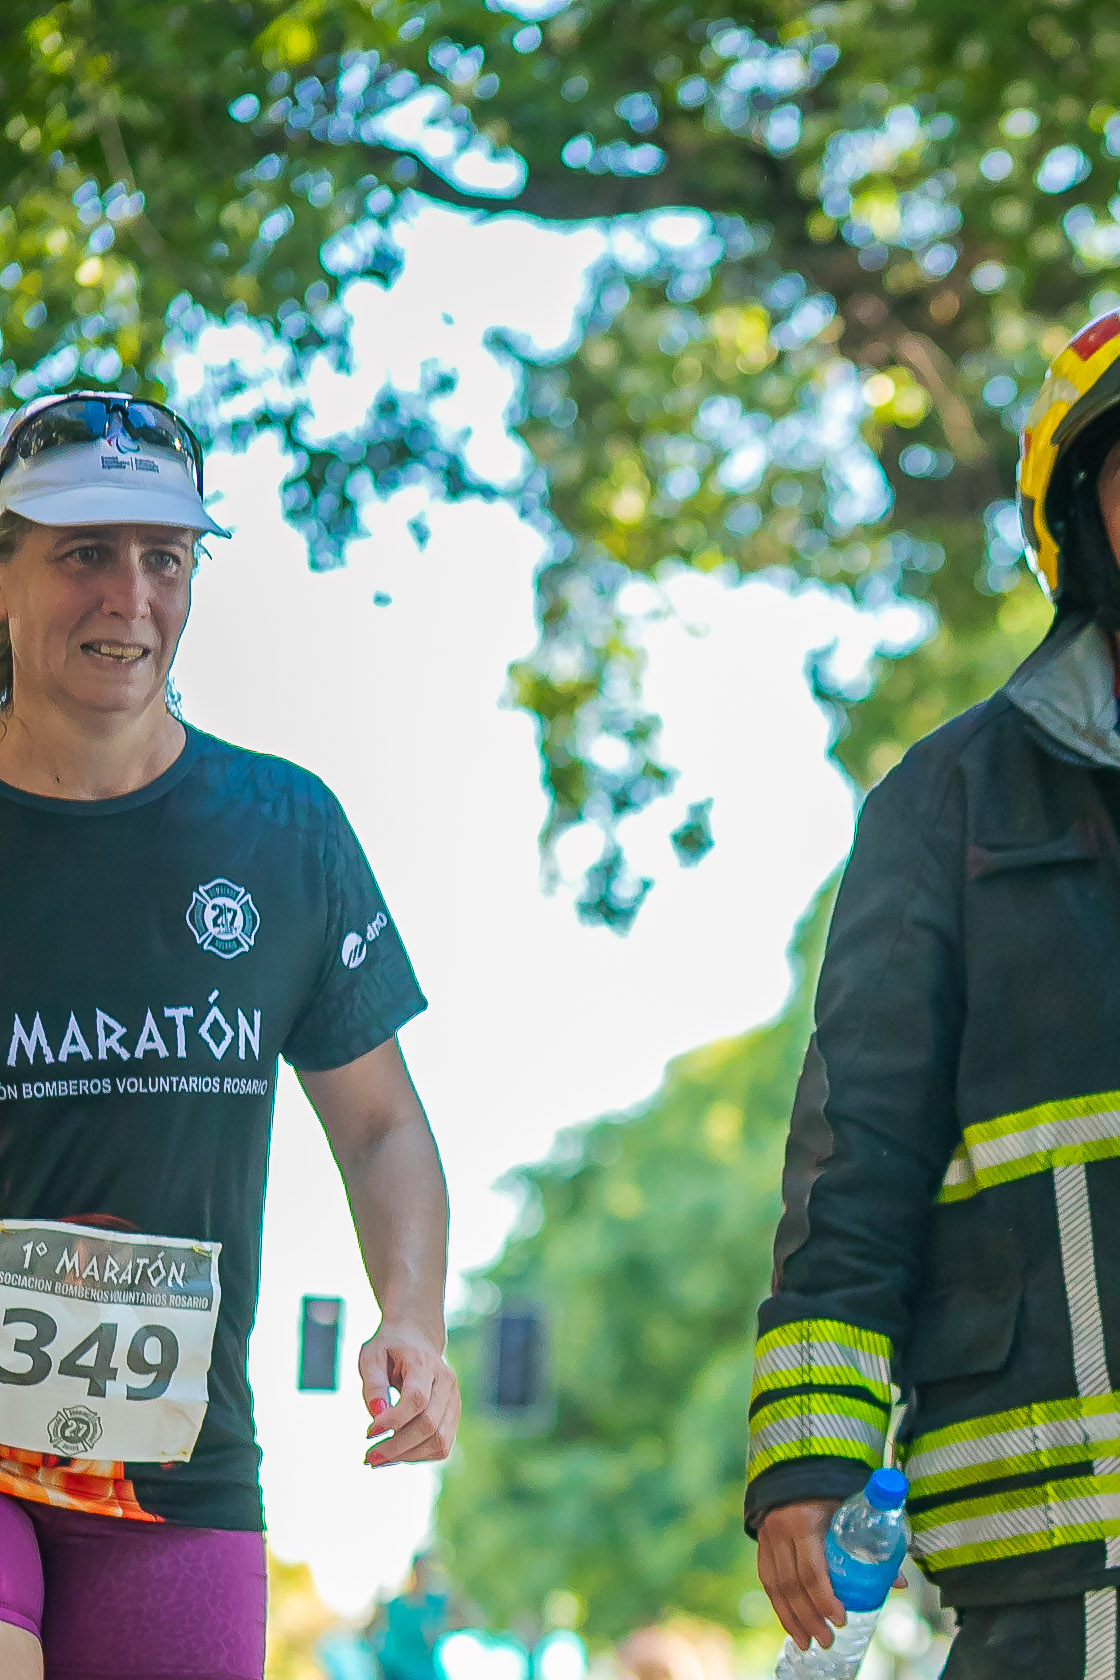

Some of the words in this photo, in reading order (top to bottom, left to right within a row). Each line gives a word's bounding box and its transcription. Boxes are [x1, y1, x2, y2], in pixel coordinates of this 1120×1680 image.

[6, 989, 262, 1066] MARATÓN
[22, 1078, 112, 1099] BOMBEROS
[115, 1075, 221, 1094] VOLUNTARIOS
[223, 1076, 268, 1096] ROSARIO
[55, 1246, 186, 1288] MARATÓN
[54, 1279, 110, 1303] BOMBEROS
[169, 1294, 209, 1310] ROSARIO
[0, 1307, 180, 1401] 349
[64, 1419, 88, 1438] 27
